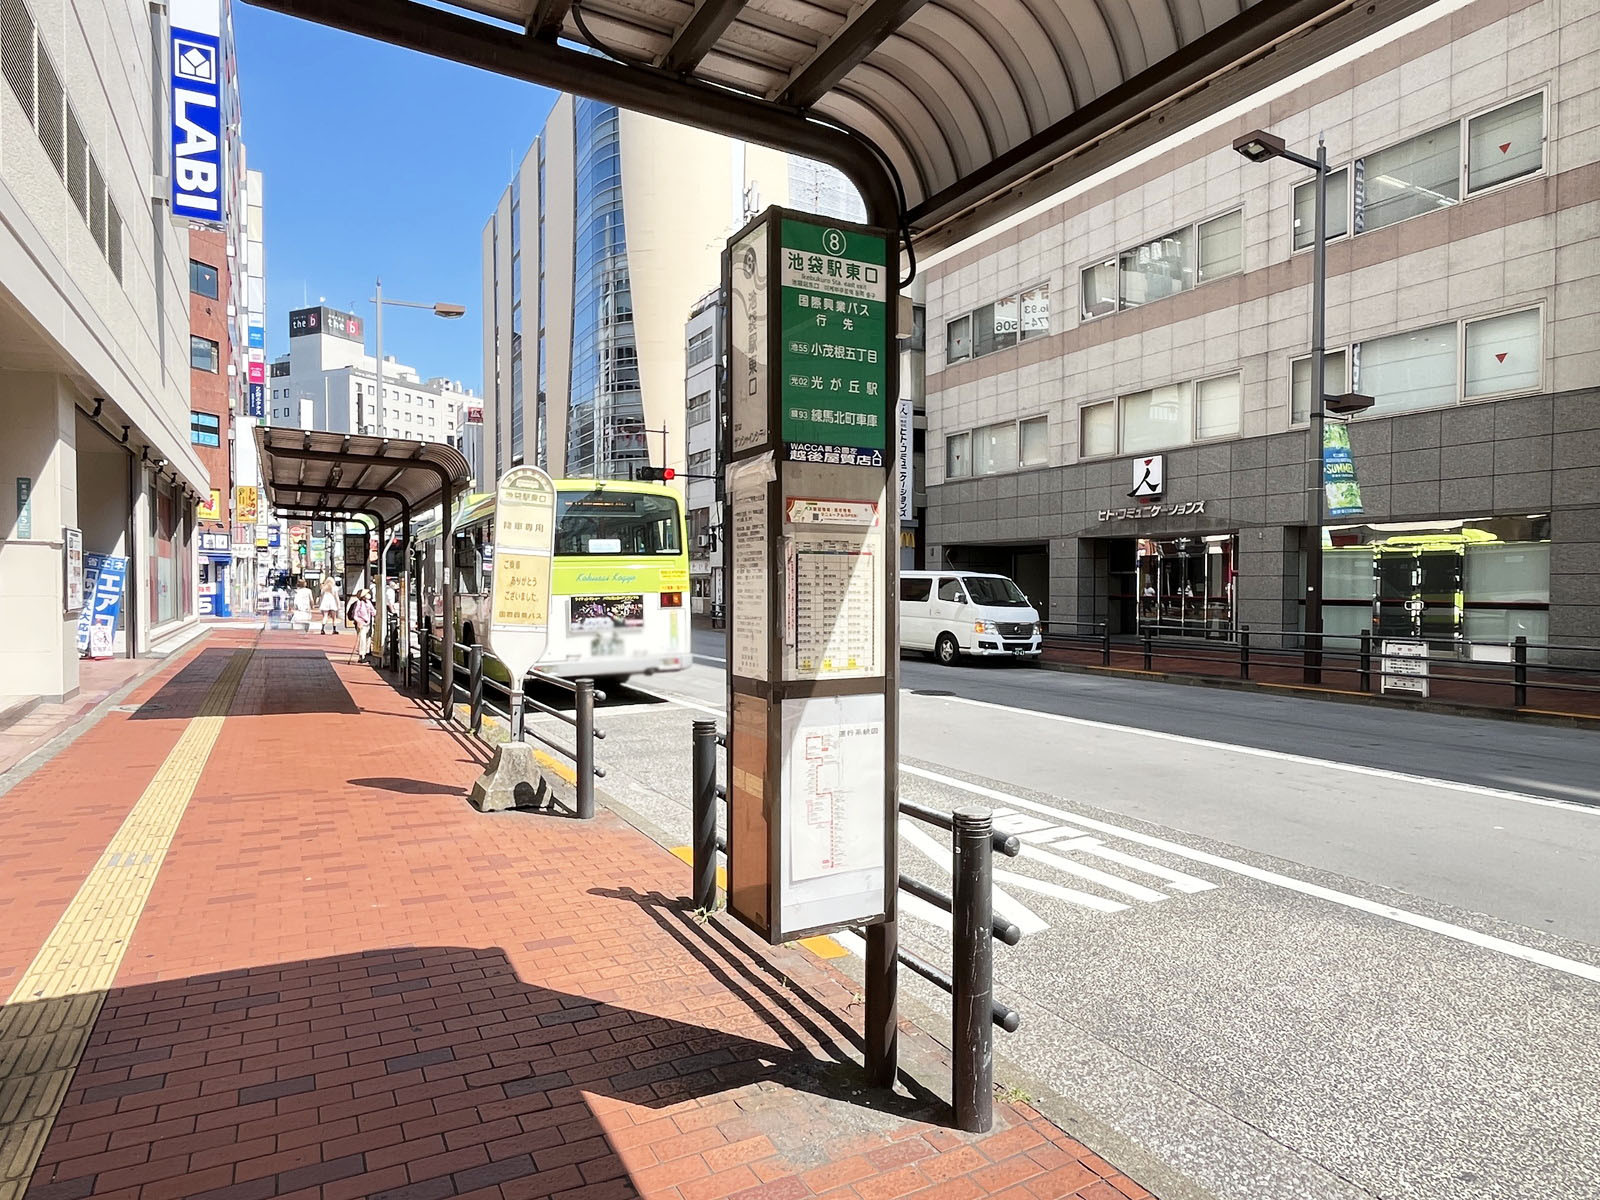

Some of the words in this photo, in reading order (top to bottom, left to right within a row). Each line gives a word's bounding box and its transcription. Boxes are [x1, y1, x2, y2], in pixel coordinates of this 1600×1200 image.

[174, 87, 218, 211] LABI
[788, 251, 878, 284] 池袋駅東口
[801, 273, 831, 284] Ikebukuro
[798, 294, 870, 316] 国際興業バス
[293, 319, 306, 329] the
[328, 318, 345, 331] the
[748, 290, 758, 397] 池袋駅東口
[811, 342, 878, 364] 小茂根五丁目
[790, 376, 808, 386] 光02
[811, 408, 878, 427] 練馬北町車庫
[789, 450, 872, 466] 越後屋質店
[872, 449, 883, 467] 入口
[1098, 500, 1206, 522] ヒト・コミュニケーションズ
[87, 557, 125, 570] 省エネ
[511, 576, 538, 587] ありがとう
